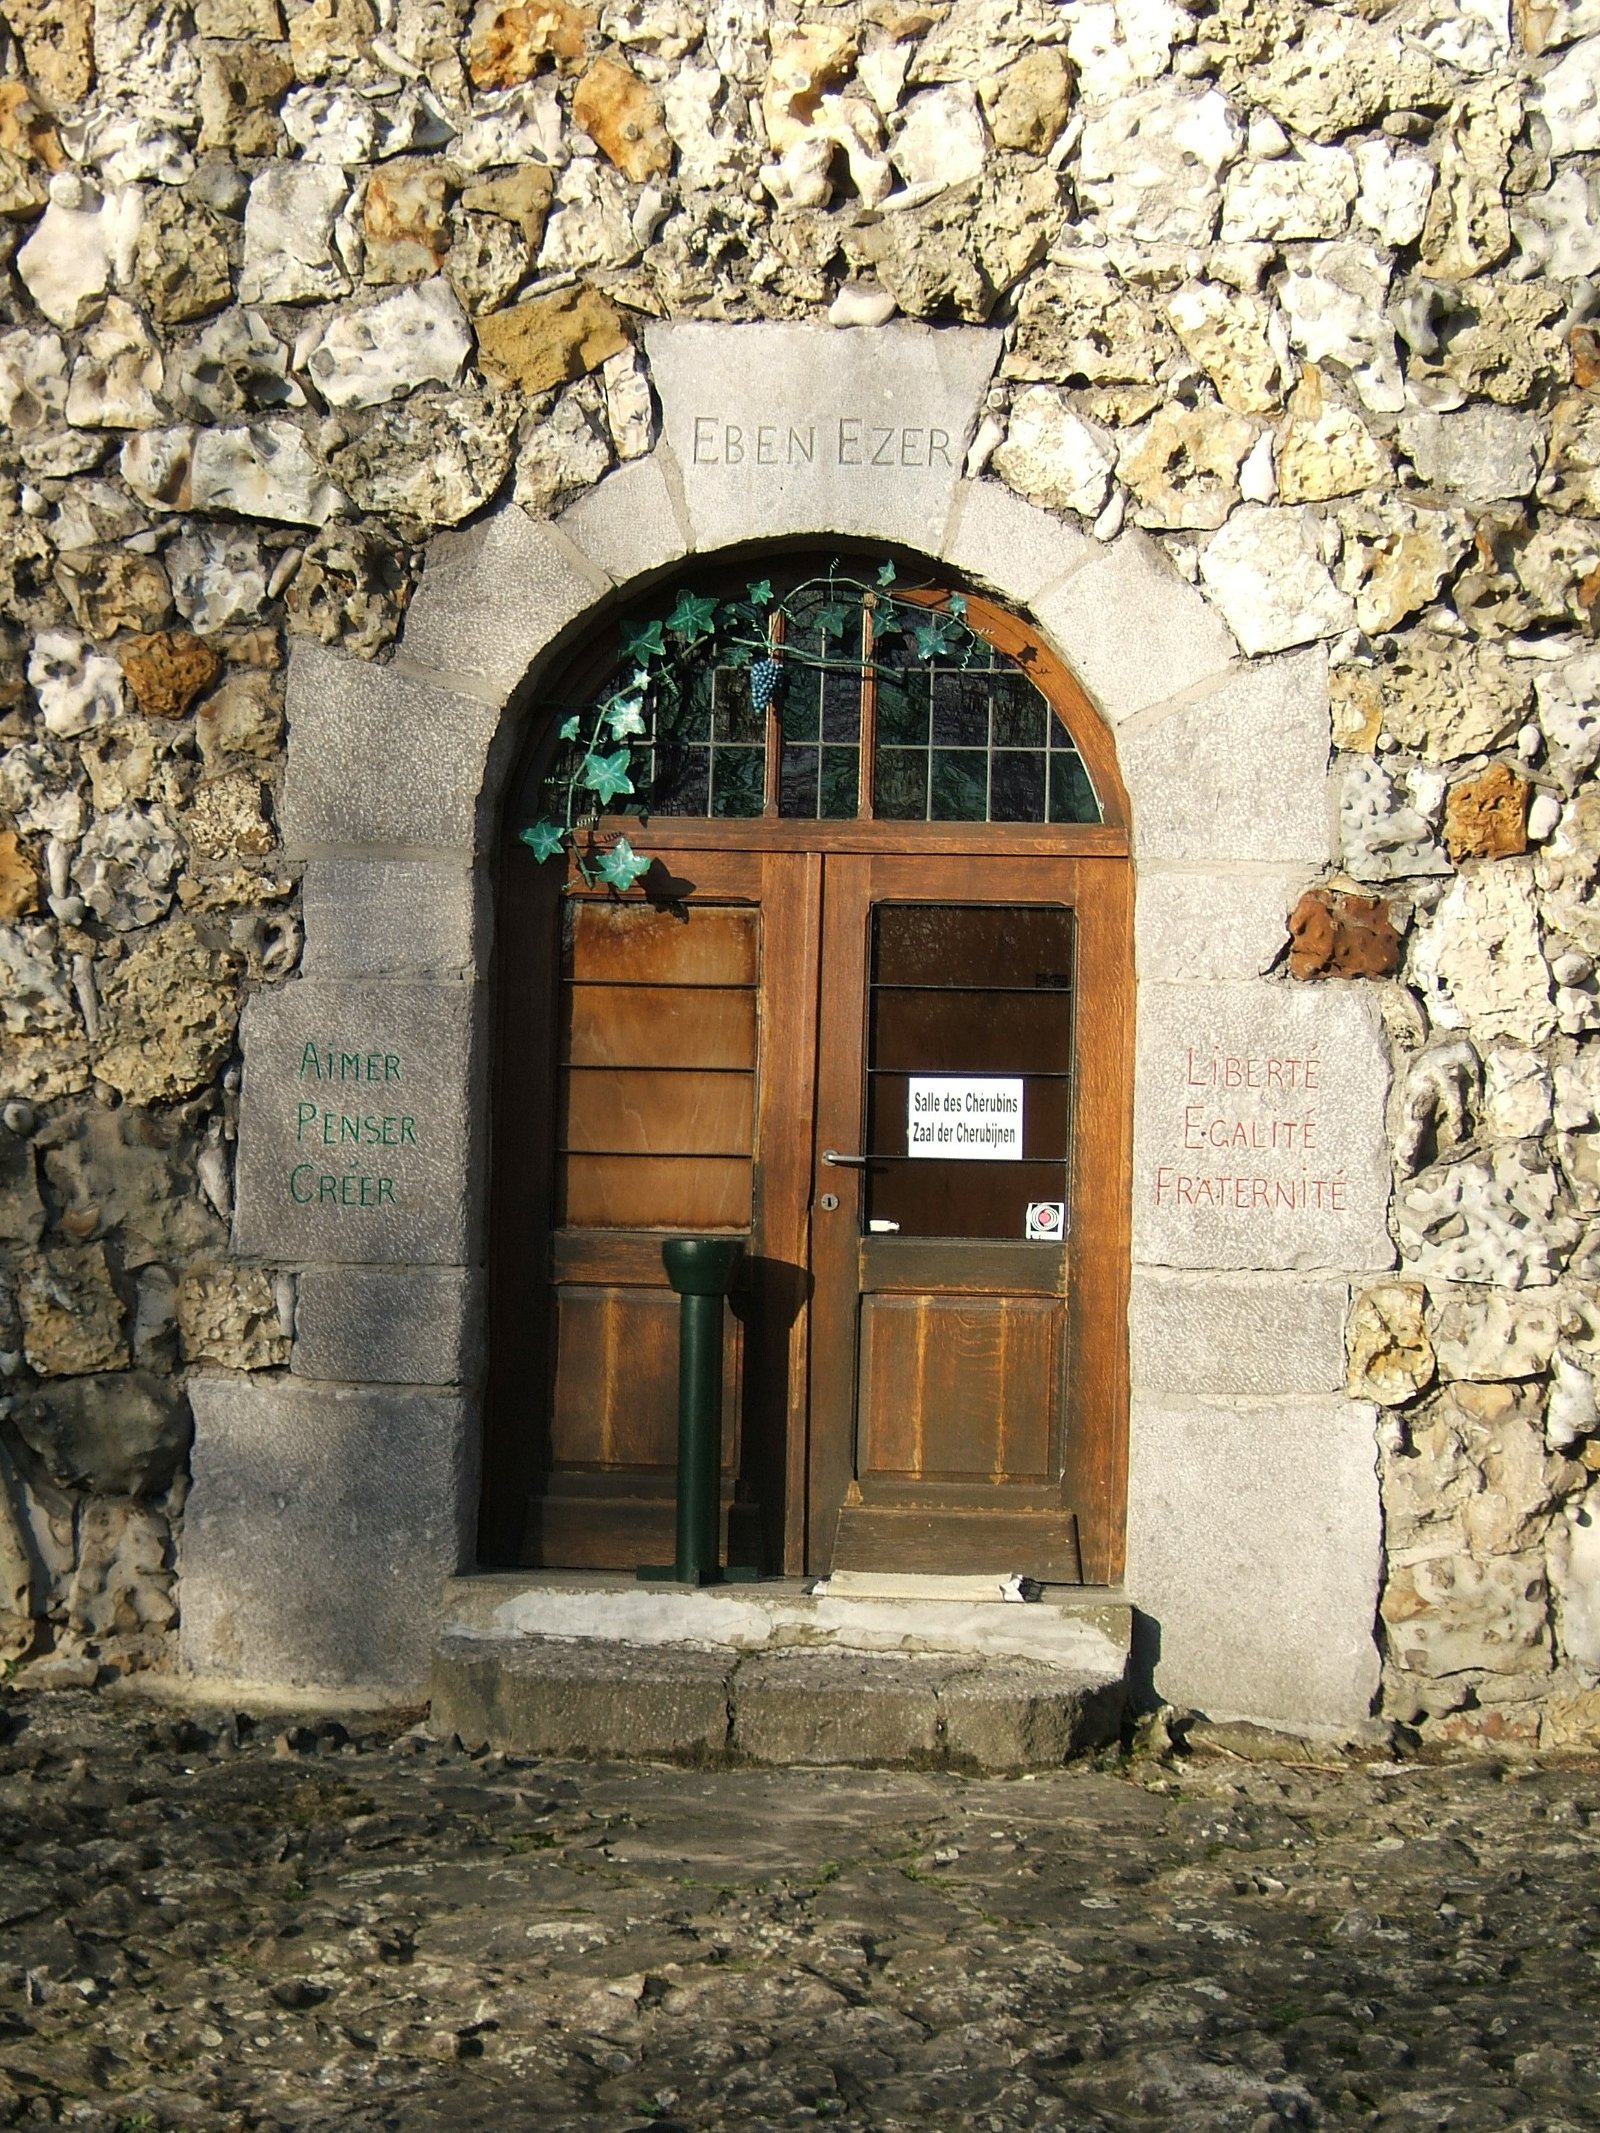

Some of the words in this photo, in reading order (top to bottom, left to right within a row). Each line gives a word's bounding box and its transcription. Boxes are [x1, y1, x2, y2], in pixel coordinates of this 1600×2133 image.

[693, 416, 816, 465] EBEN
[838, 417, 953, 467] EZER
[297, 1102, 417, 1145] PENSER
[914, 1091, 941, 1112] Salle
[943, 1092, 962, 1113] des
[965, 1092, 1018, 1113] Chérubins
[913, 1122, 935, 1142] Zaal
[937, 1122, 954, 1143] der
[956, 1122, 1016, 1149] Cherubijnen
[290, 1160, 397, 1207] CRÉER
